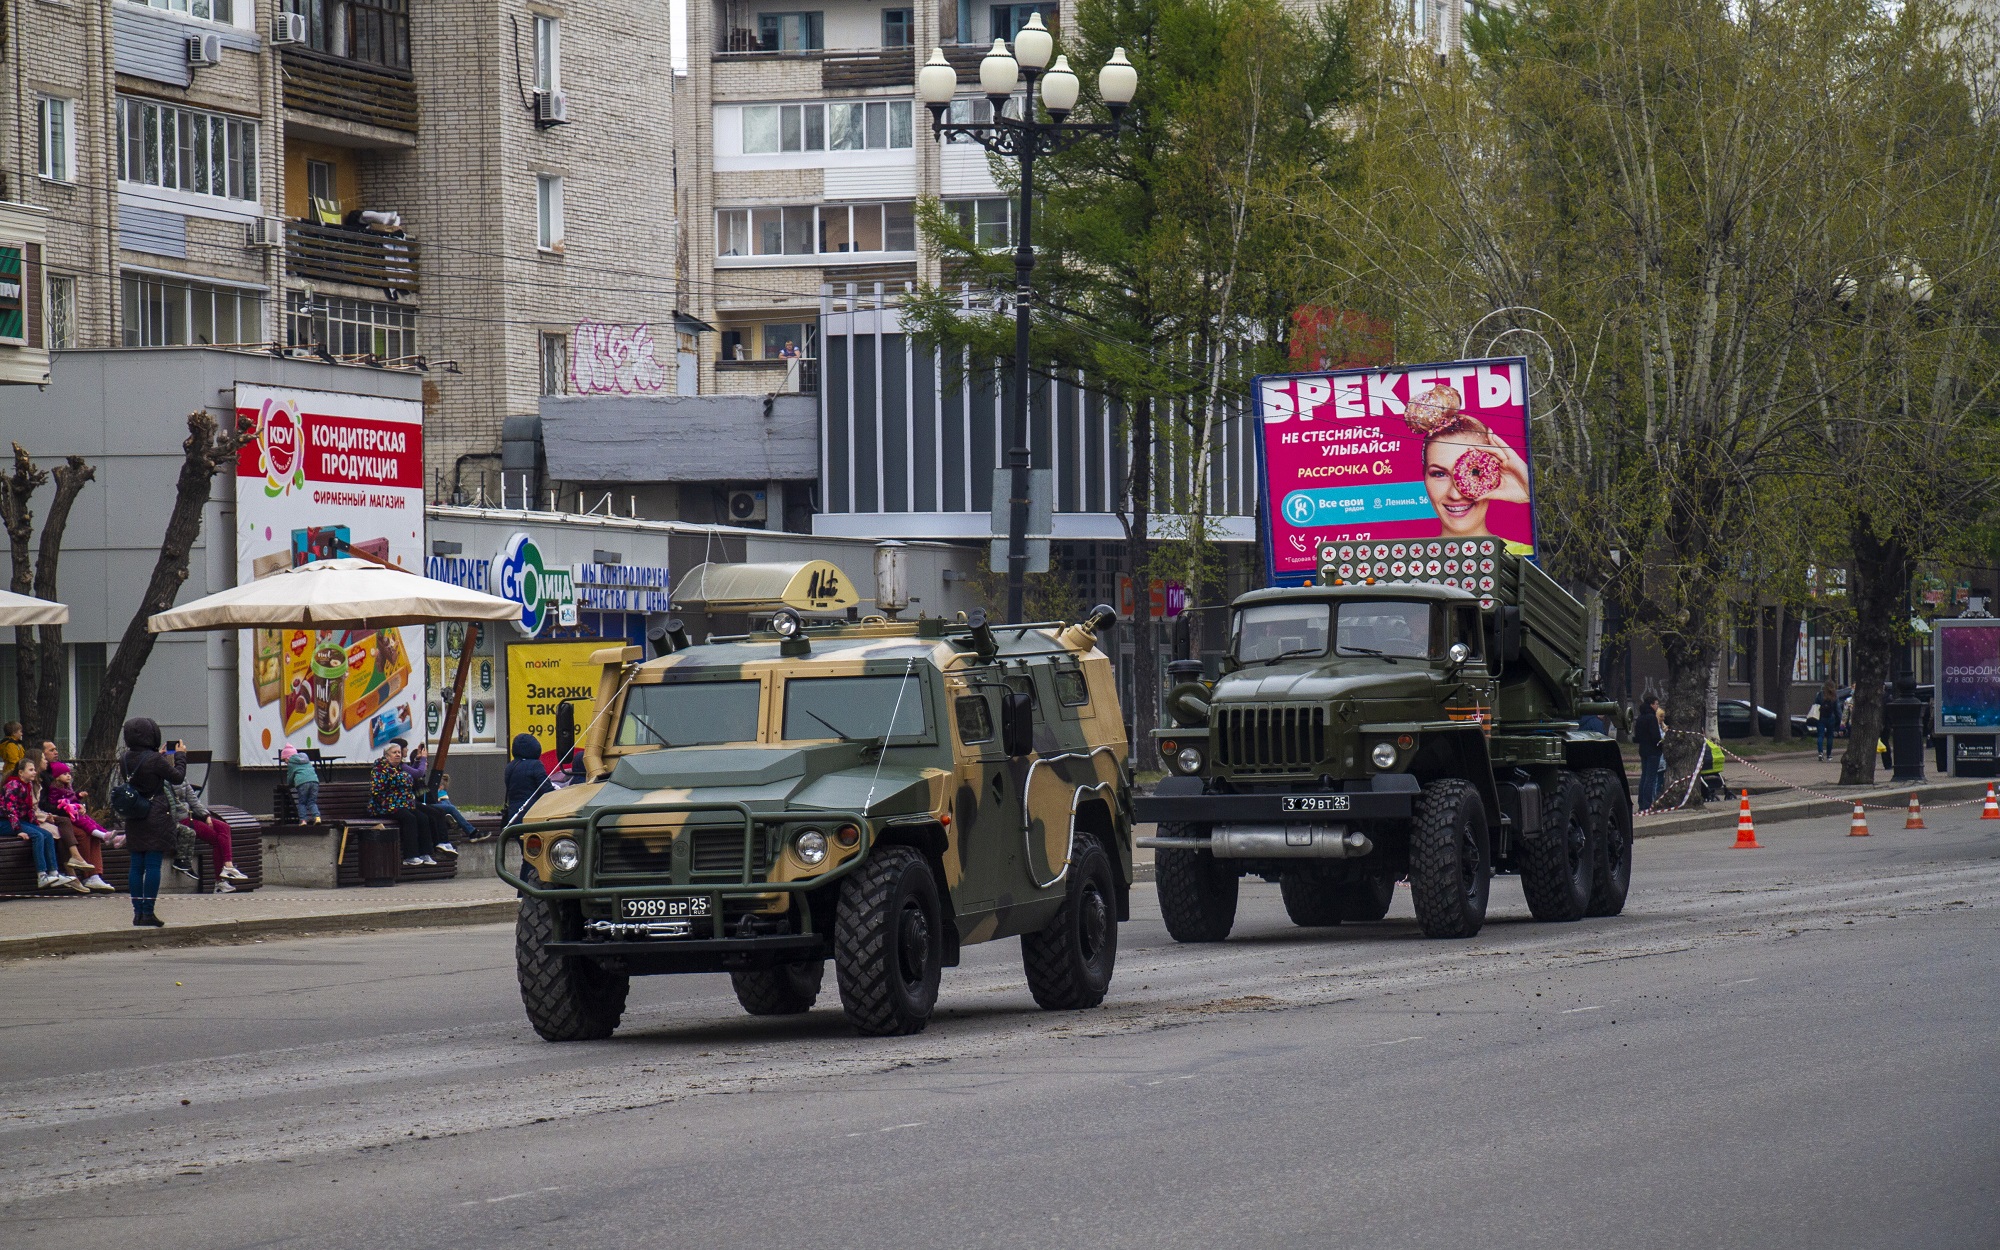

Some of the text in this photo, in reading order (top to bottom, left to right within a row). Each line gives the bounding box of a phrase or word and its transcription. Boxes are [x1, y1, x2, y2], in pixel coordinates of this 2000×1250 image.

[1261, 364, 1524, 424] БРЕКЕТЫ
[270, 426, 293, 445] KDV
[312, 424, 406, 453] КОНДИТЕРСКАЯ
[1281, 426, 1384, 444] НЕ СТЕСНЯЙСЯ,
[1321, 440, 1401, 456] УЛЫБАЙСЯ!
[321, 453, 398, 482] ПРОДУКЦИЯ
[1297, 464, 1369, 478] РАССРОЧКА
[313, 490, 405, 510] ФИРМЕННЫЙ МАГАЗИН
[1318, 498, 1364, 508] Все свои
[1385, 498, 1418, 506] Ленина,
[582, 563, 669, 588] МЫ КОНТРОЛИРУЕМ
[581, 588, 670, 613] КАЧЕСТВО И ЦЕНЫ
[1121, 577, 1165, 616] DS
[525, 658, 560, 669] maxim
[526, 683, 592, 698] Закажи
[526, 703, 574, 716] так
[1287, 798, 1316, 809] 329
[1334, 797, 1345, 806] 25
[628, 898, 706, 916] 9989 ВР 25
